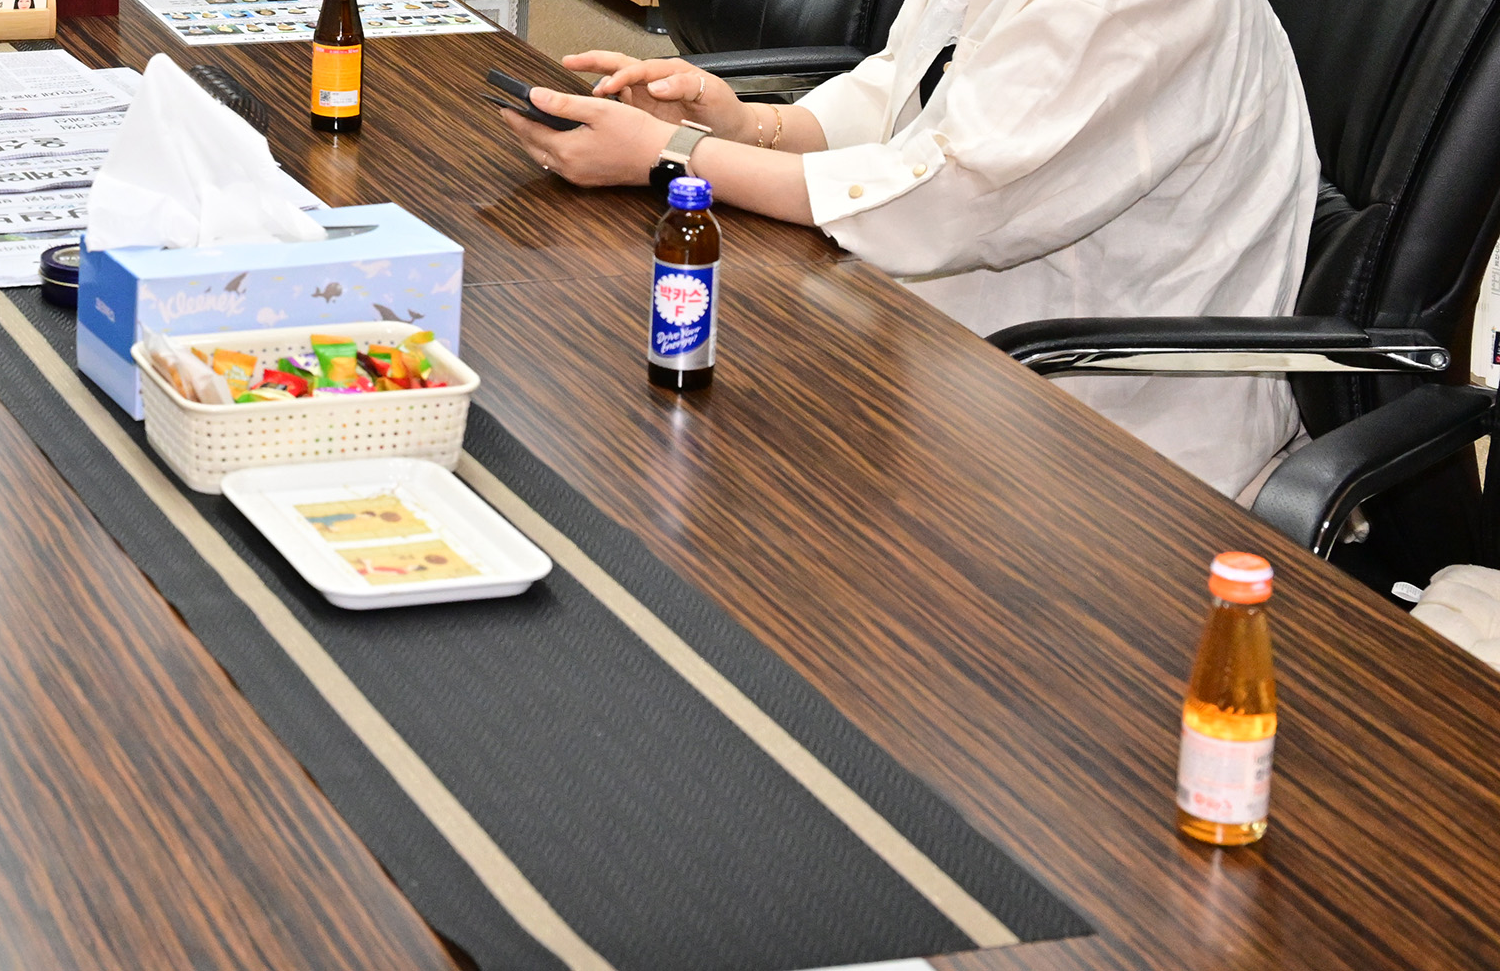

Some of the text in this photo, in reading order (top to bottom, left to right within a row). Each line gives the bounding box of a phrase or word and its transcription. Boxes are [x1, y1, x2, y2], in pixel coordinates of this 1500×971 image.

[660, 285, 702, 303] 박카스
[158, 291, 248, 325] Kleenex
[675, 305, 685, 317] F
[656, 326, 702, 345] Drive Your
